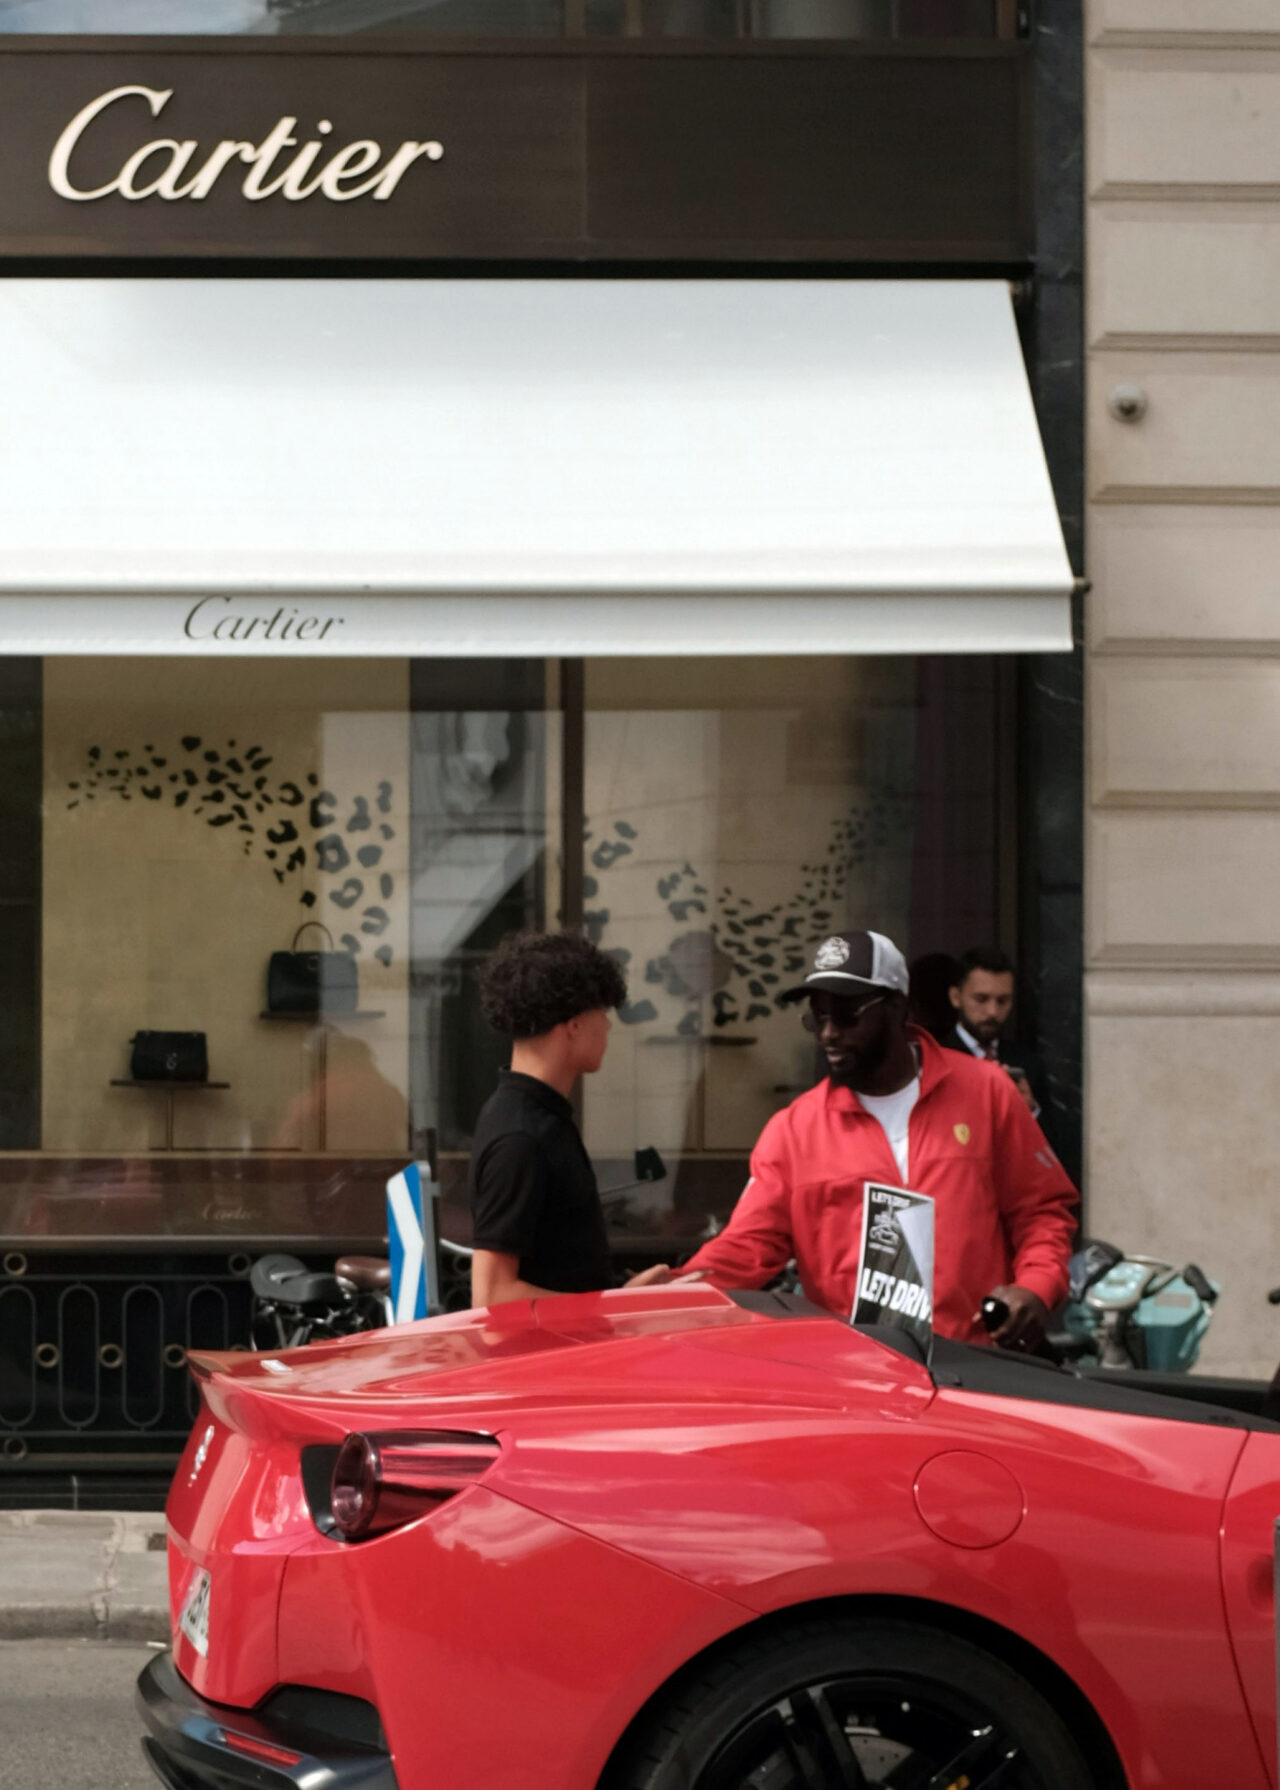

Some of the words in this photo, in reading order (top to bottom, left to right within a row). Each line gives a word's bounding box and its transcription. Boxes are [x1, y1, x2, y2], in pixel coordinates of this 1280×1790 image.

[48, 85, 444, 201] Cartier
[184, 594, 345, 640] Cartier
[889, 1279, 932, 1323] DRIV
